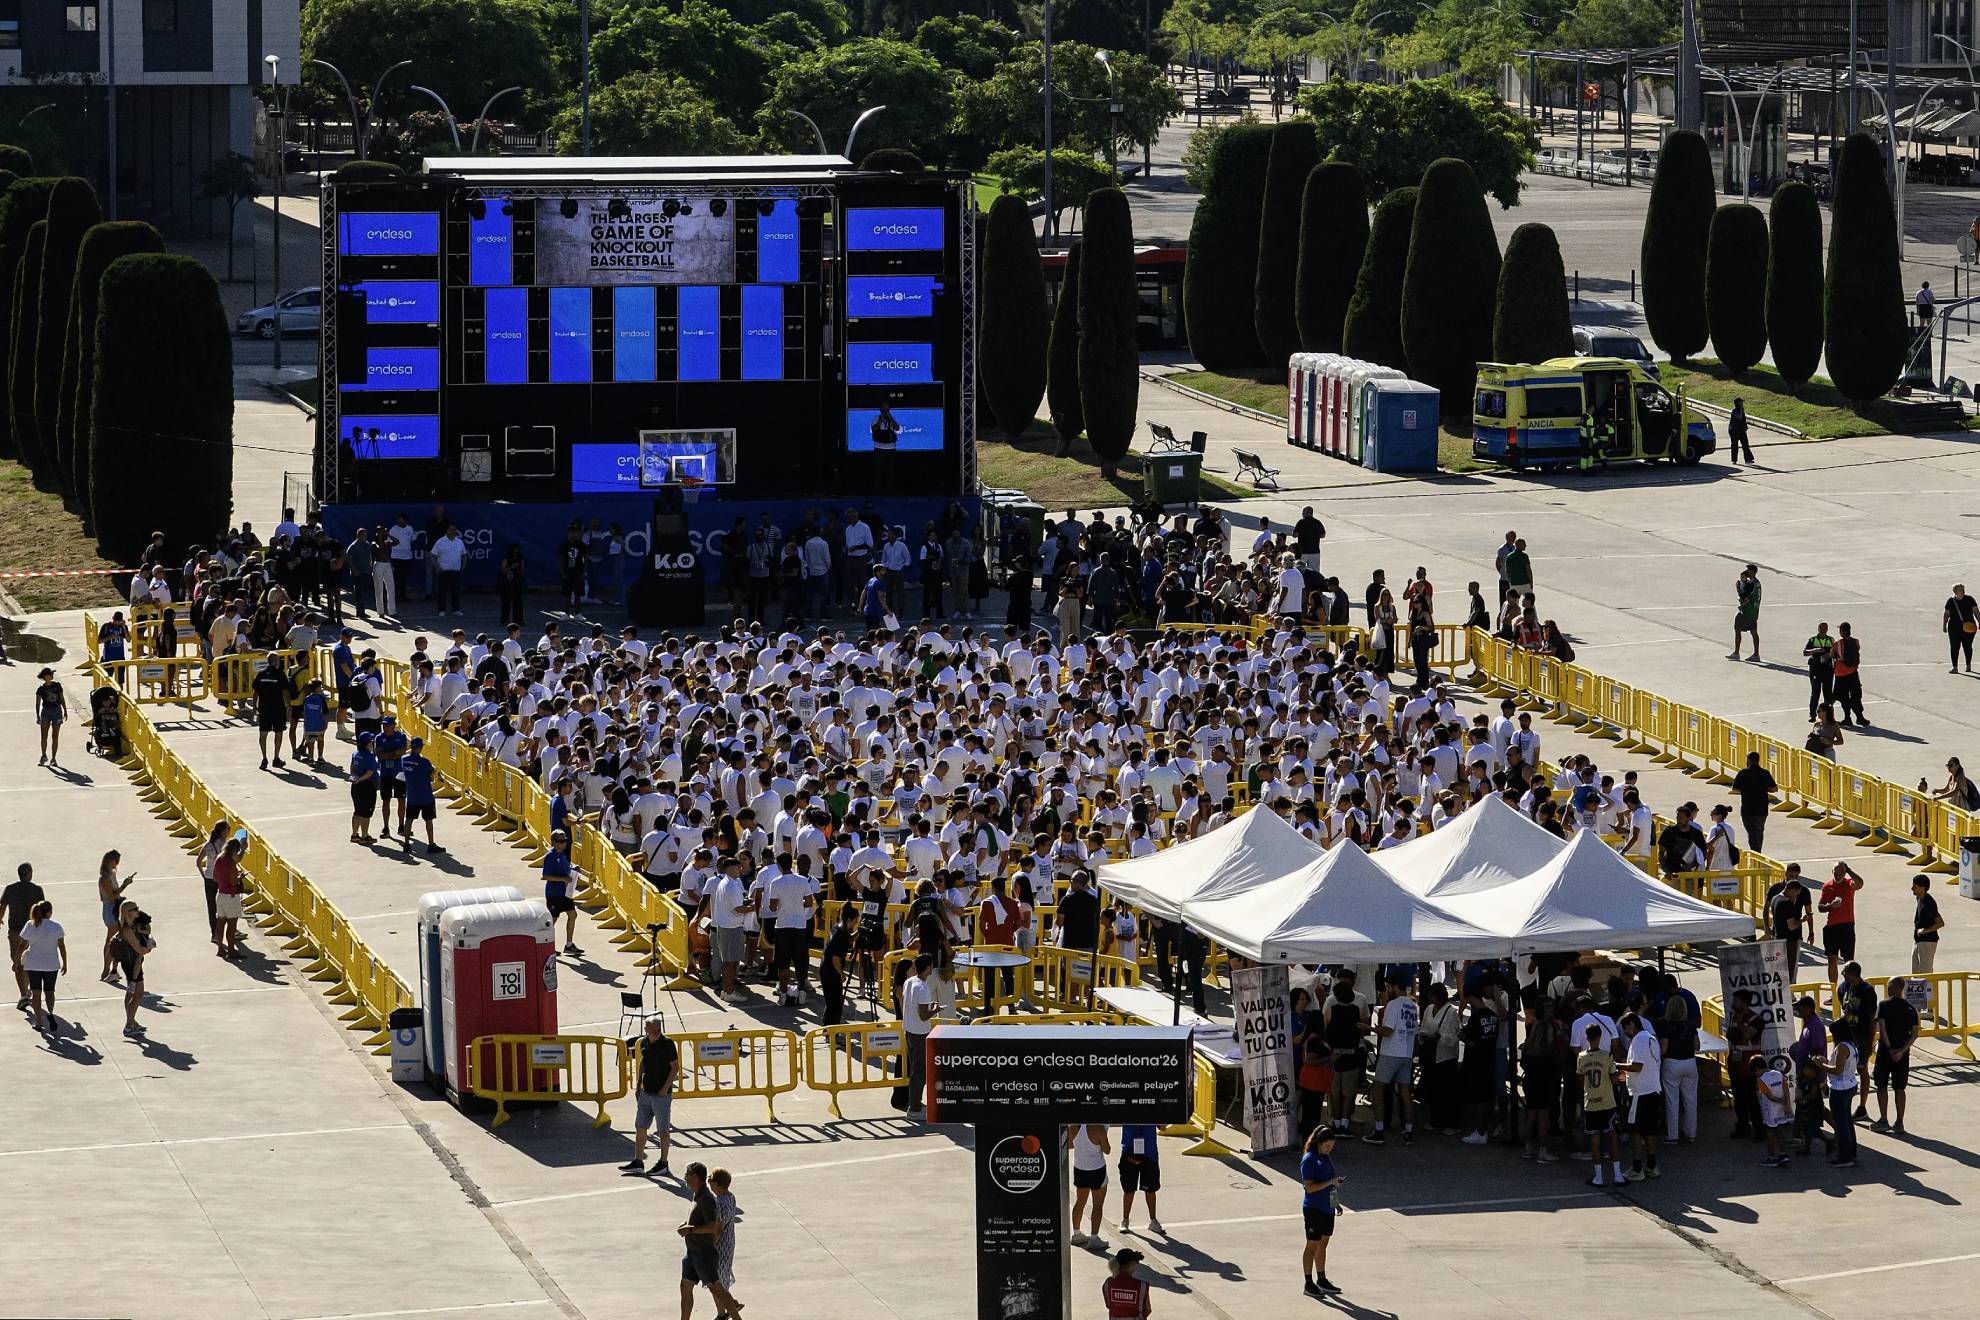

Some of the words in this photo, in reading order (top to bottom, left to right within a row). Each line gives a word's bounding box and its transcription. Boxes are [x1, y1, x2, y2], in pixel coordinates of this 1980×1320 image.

[591, 213, 618, 224] THE
[619, 213, 674, 224] LARGEST
[367, 229, 412, 240] endesa
[591, 225, 645, 239] GAME
[649, 225, 675, 239] OF
[873, 224, 918, 235] endesa
[476, 235, 507, 243] endesa
[764, 232, 794, 240] endesa
[591, 241, 675, 254] KNOCKOUT
[591, 255, 675, 267] BASKETBALL
[868, 292, 894, 301] Basket
[491, 331, 522, 339] endesa
[747, 328, 778, 336] endesa
[367, 364, 413, 375] endesa
[873, 359, 918, 369] endesa
[654, 553, 695, 569] K.O
[500, 972, 520, 984] TOI
[1728, 971, 1782, 988] VALIDA
[500, 984, 520, 995] TOI
[1750, 983, 1784, 1007] QUÍ
[1241, 996, 1285, 1014] VALIDA
[1761, 1008, 1787, 1024] QR
[1245, 1038, 1262, 1054] TU
[1265, 1035, 1287, 1050] QR
[934, 1054, 1019, 1068] supercopa
[1023, 1052, 1085, 1067] endesa
[1089, 1054, 1178, 1067] Badalona'26
[991, 1080, 1038, 1091] endesa
[1144, 1081, 1174, 1092] pelayo
[1250, 1082, 1290, 1108] K.O
[999, 1163, 1040, 1173] endesa
